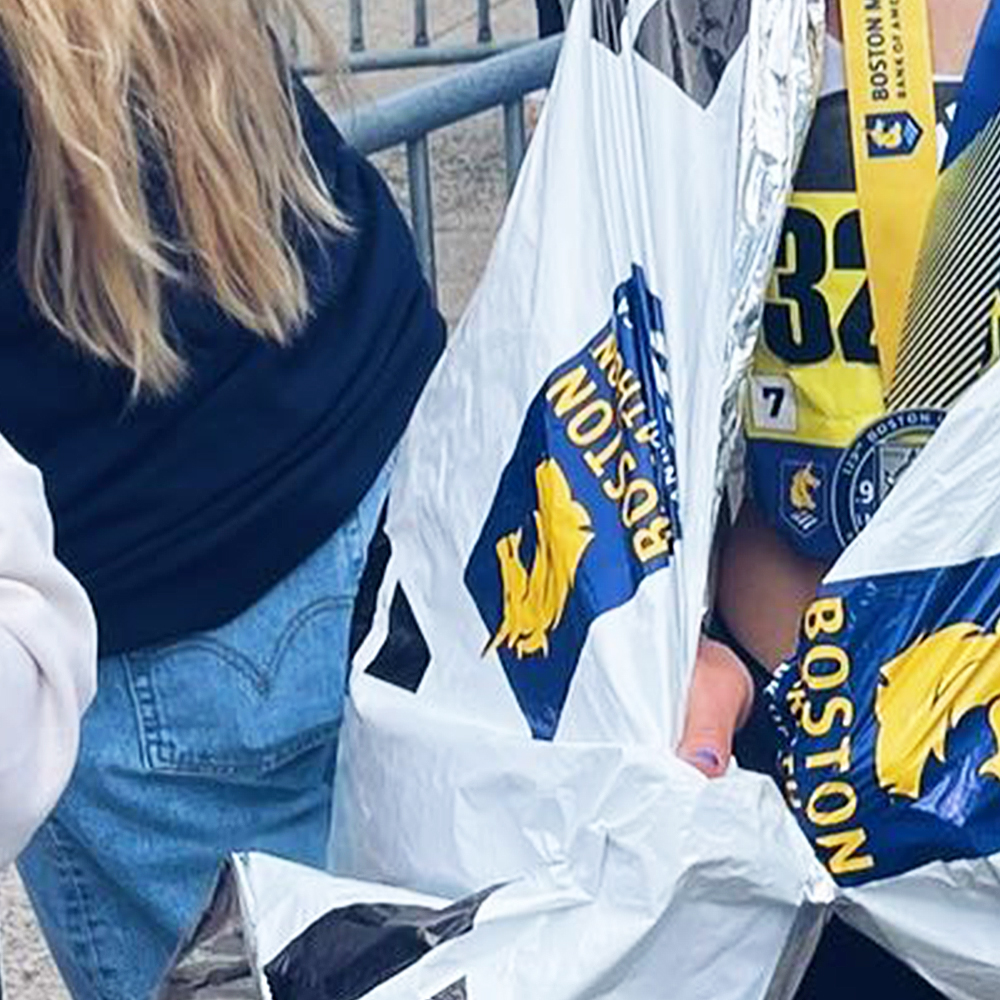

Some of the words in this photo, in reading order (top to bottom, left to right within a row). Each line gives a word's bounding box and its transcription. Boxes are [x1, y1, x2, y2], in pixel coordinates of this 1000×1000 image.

[866, 17, 889, 101] BOSTON
[893, 35, 904, 53] OF
[895, 58, 907, 99] BANK
[762, 386, 785, 418] 7
[865, 412, 931, 443] BOSTON
[801, 596, 875, 875] BOSTON
